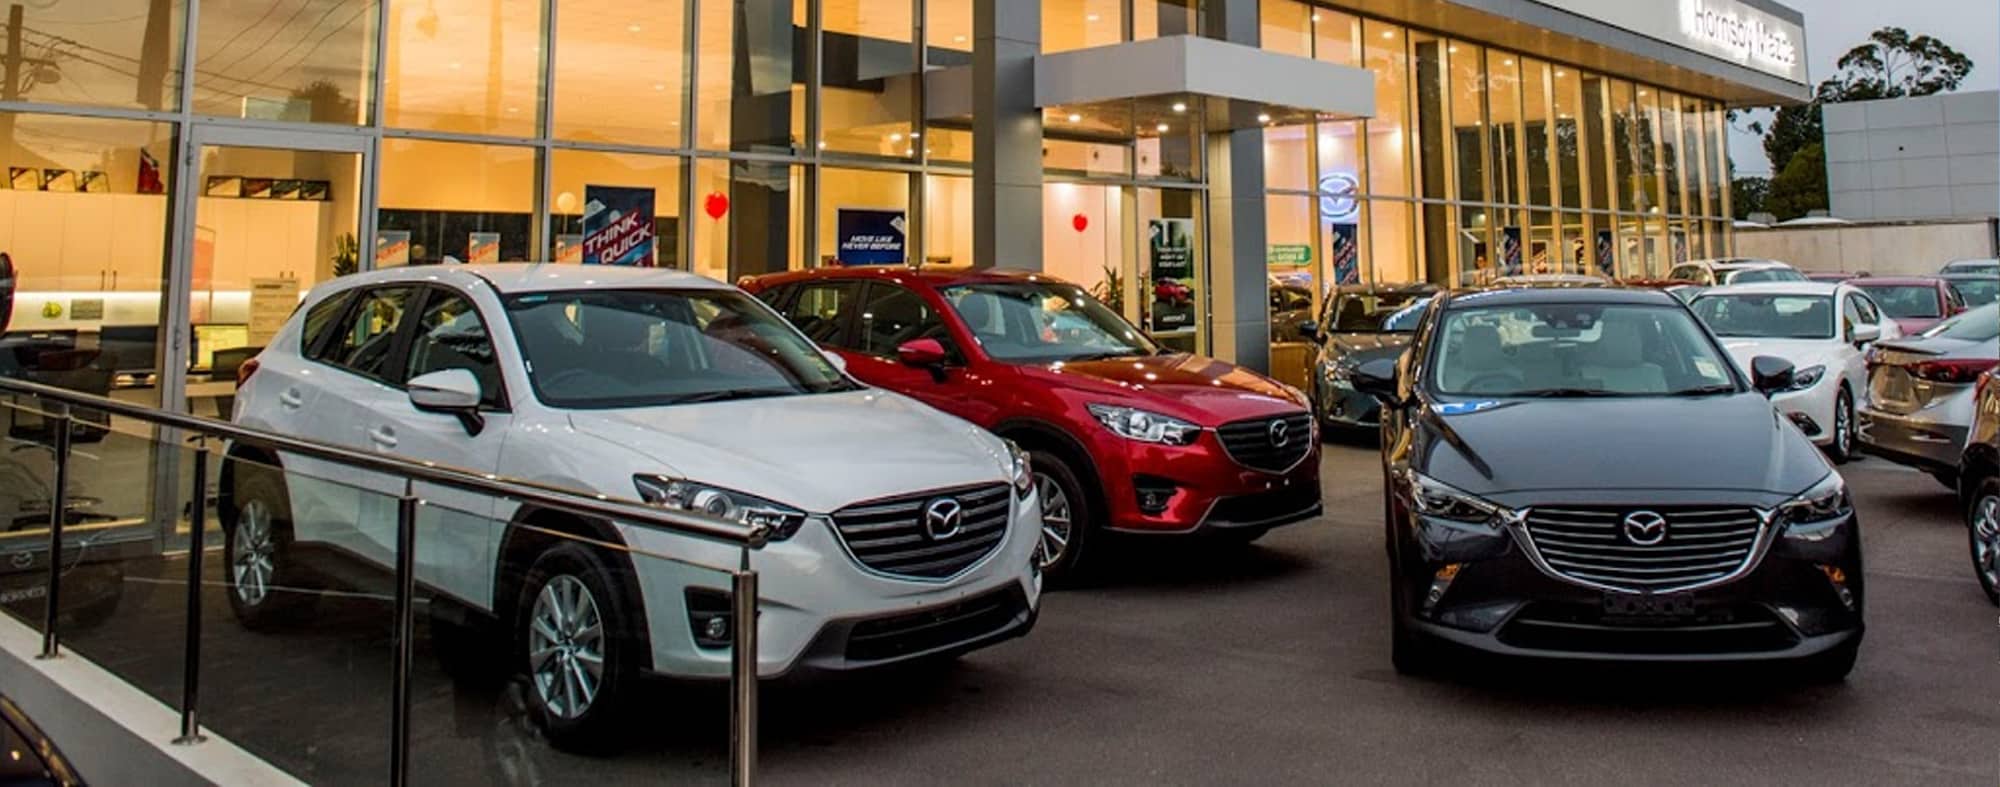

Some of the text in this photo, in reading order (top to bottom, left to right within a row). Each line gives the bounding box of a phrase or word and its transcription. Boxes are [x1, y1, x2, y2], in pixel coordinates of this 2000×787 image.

[584, 211, 638, 254] THINK
[600, 222, 652, 264] QUICK
[850, 235, 875, 243] MOVE
[841, 242, 902, 250] NEVER BEFORE
